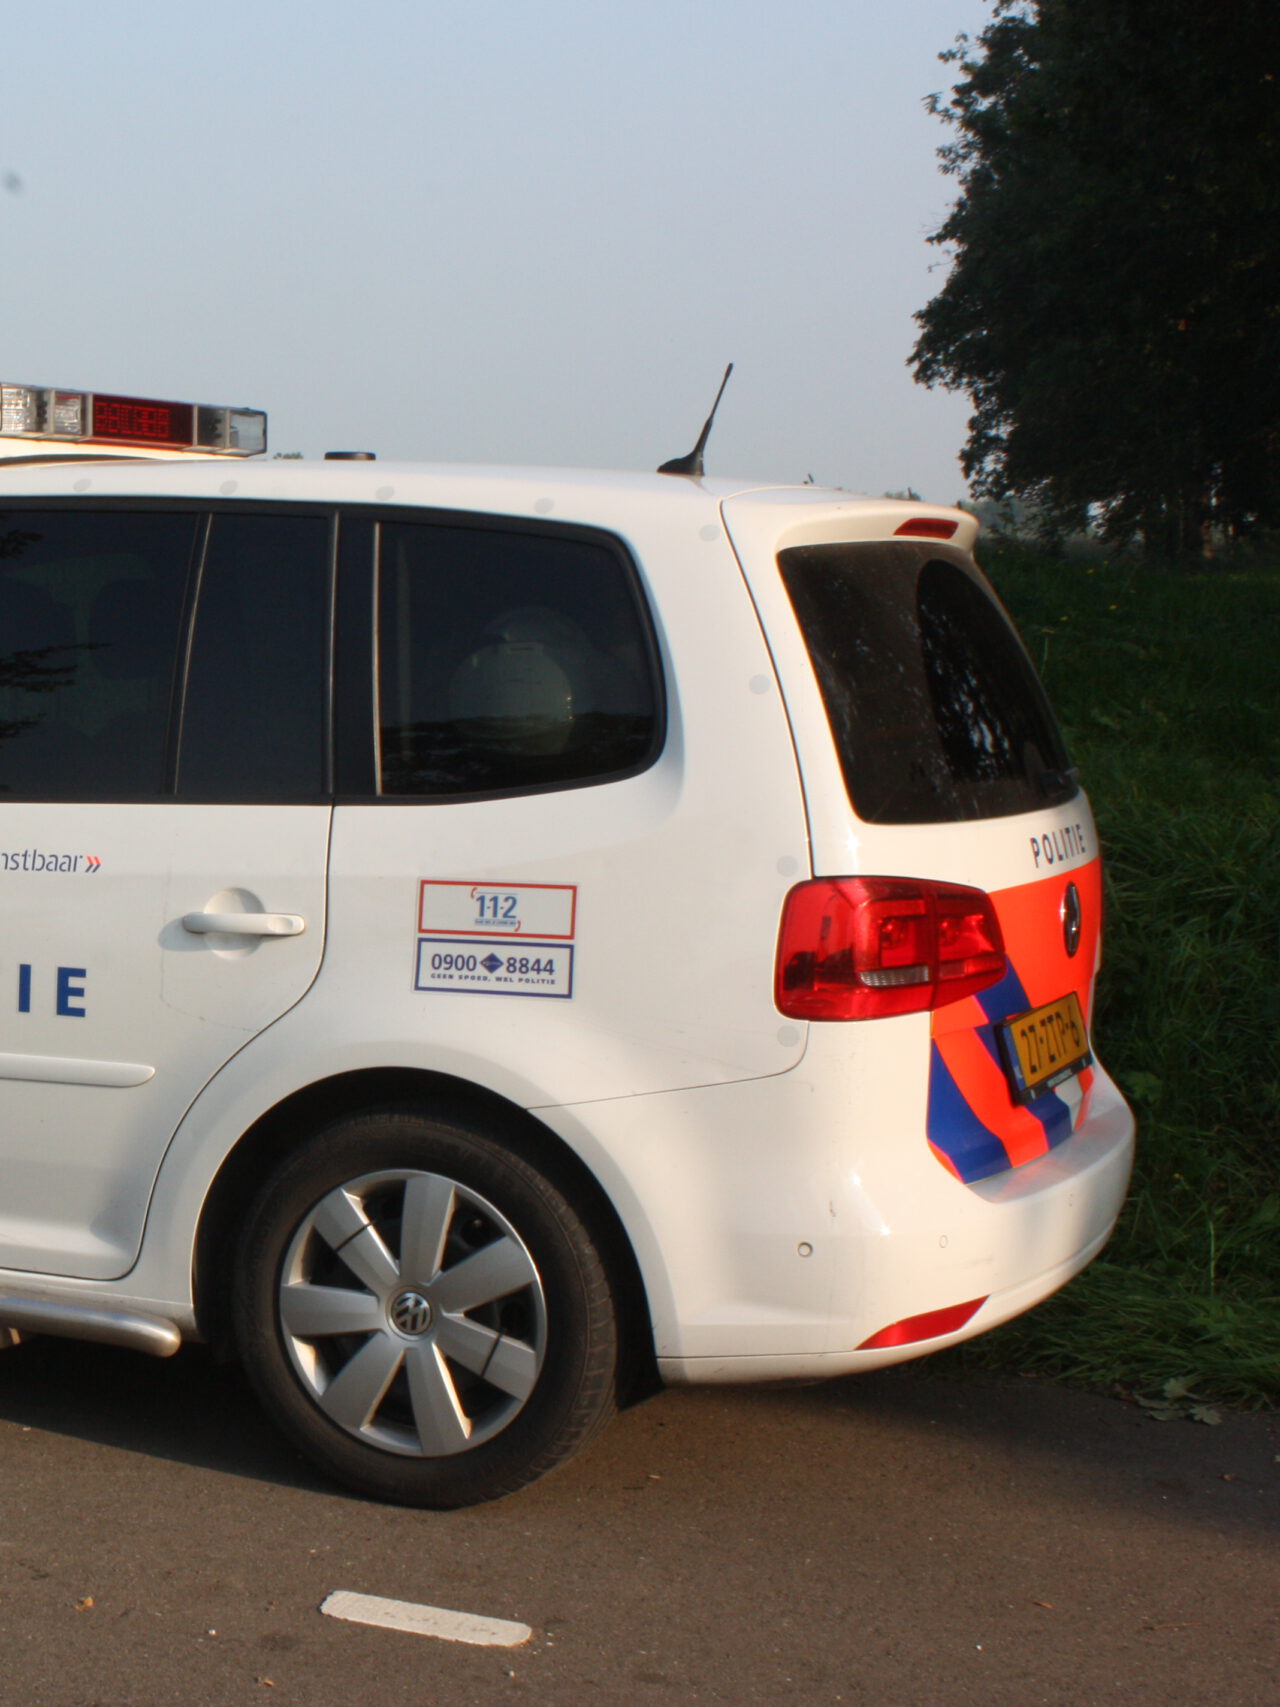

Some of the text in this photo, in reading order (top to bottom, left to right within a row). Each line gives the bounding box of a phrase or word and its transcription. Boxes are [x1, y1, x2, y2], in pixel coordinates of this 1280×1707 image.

[1030, 824, 1087, 868] POLITIE
[431, 953, 555, 976] 0900 8844
[518, 977, 556, 985] POLITIE
